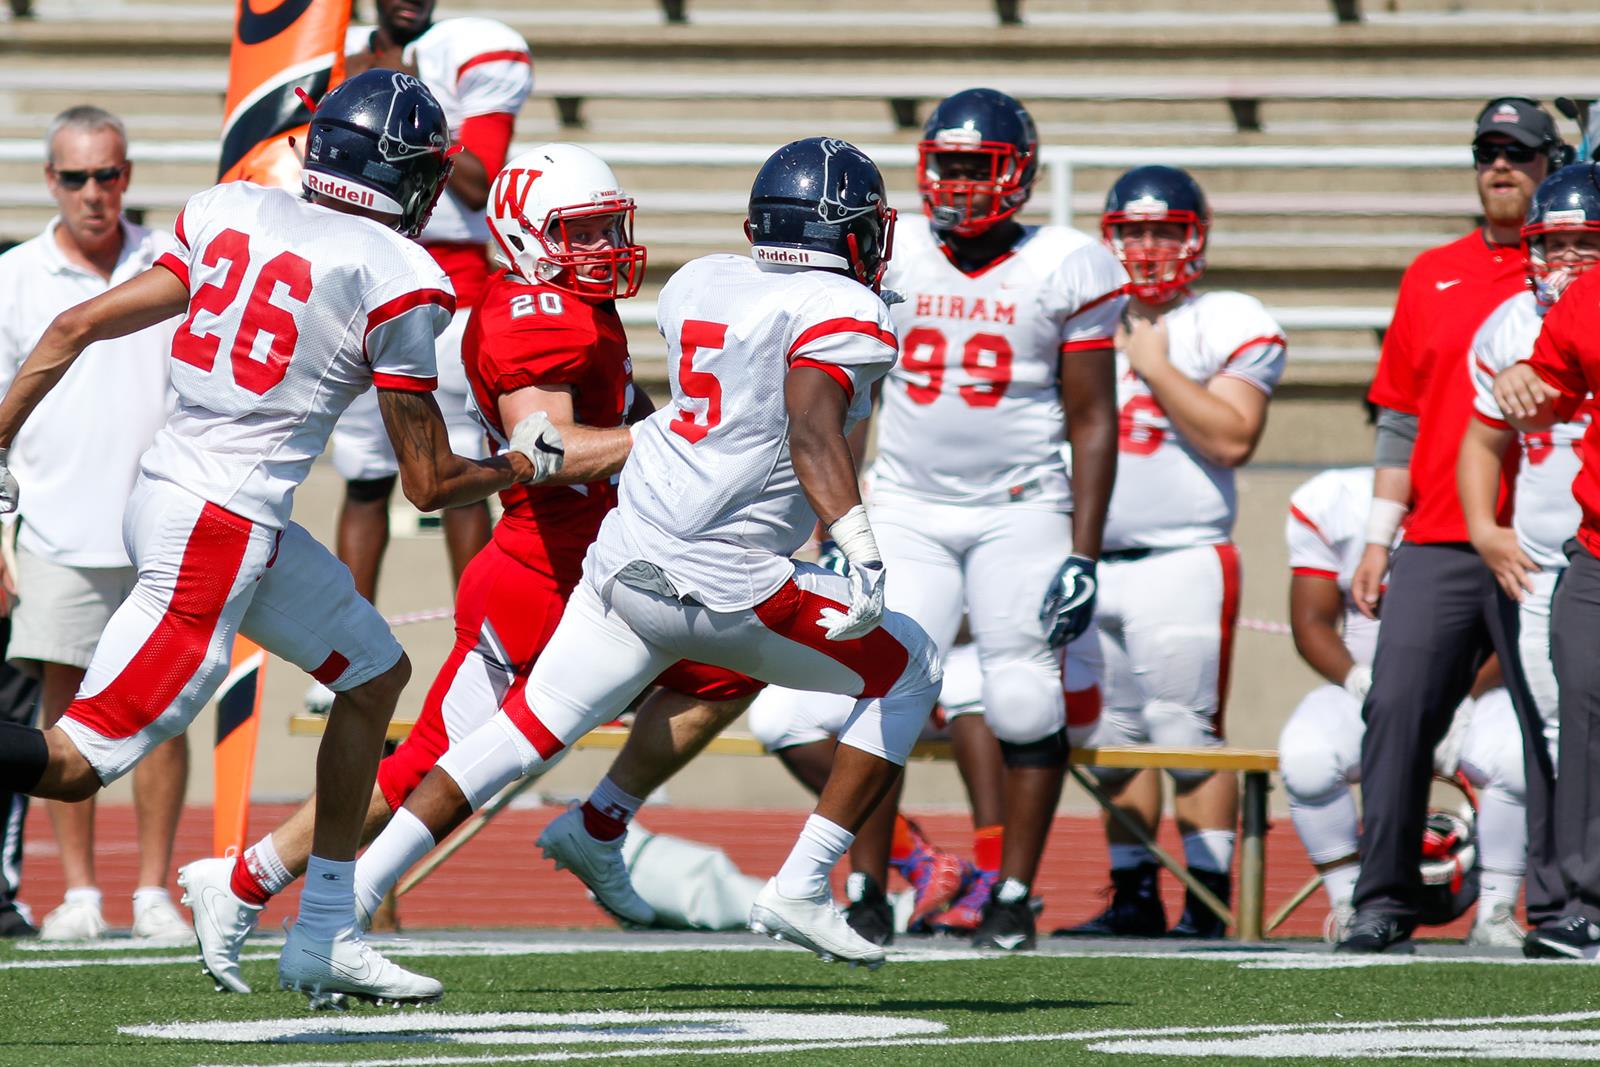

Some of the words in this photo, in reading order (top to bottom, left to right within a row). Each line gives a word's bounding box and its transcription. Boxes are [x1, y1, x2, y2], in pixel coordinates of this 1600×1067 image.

[308, 174, 375, 207] Riddell
[758, 249, 810, 263] Riddell
[171, 228, 312, 395] 26
[510, 292, 565, 320] 20
[915, 292, 1016, 325] HIRAM
[669, 319, 729, 445] 5
[901, 326, 1013, 408] 99
